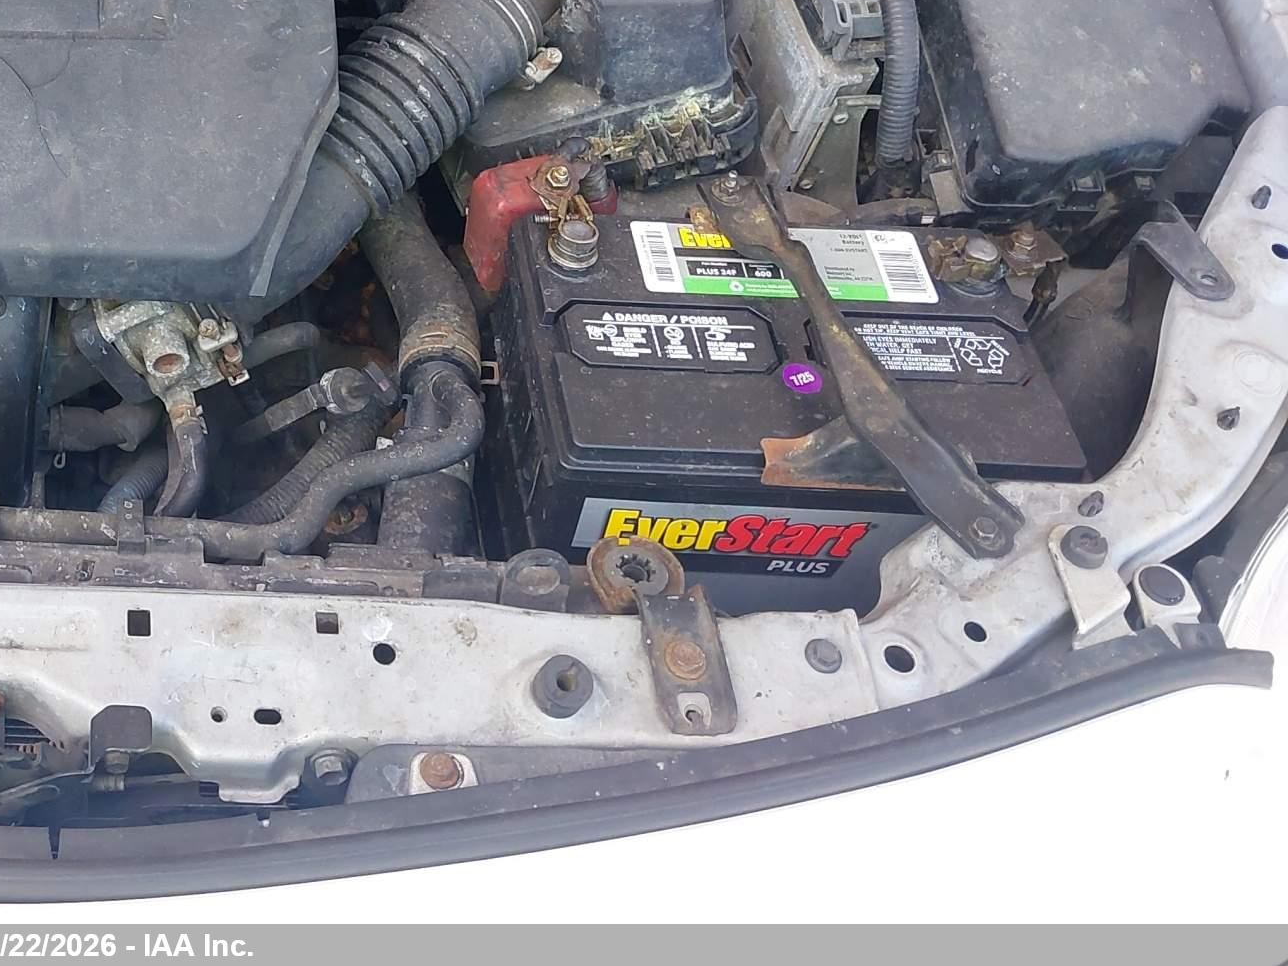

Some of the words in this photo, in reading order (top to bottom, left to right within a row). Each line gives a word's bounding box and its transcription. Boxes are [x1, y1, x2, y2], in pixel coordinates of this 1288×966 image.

[696, 267, 719, 275] PLUS
[615, 313, 668, 323] DANGER
[669, 315, 678, 324] /
[679, 316, 729, 325] POISON
[789, 371, 815, 386] 7/25
[602, 508, 872, 559] EverStart
[766, 559, 830, 575] PLUS
